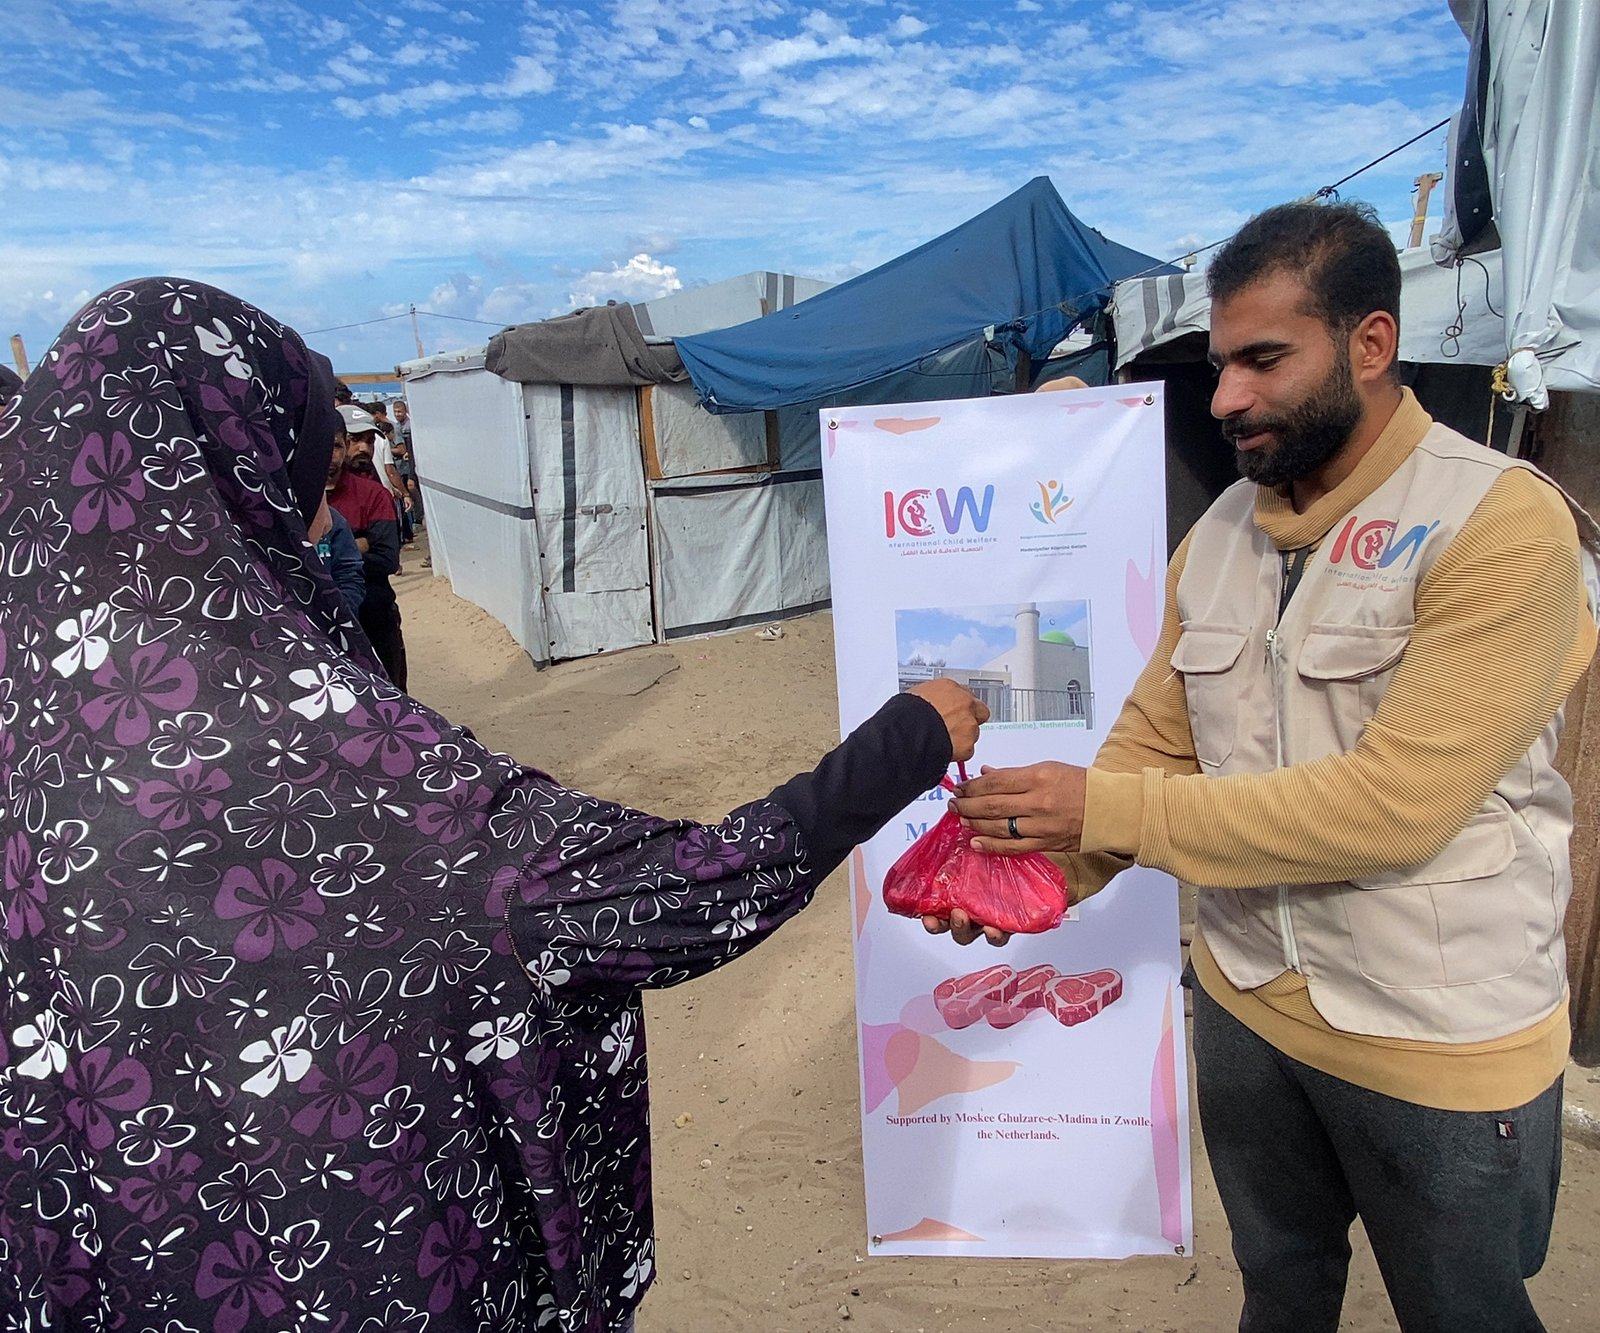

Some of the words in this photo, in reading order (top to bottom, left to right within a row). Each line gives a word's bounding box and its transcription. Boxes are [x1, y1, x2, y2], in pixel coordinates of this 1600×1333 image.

[884, 484, 994, 538] ICW
[888, 539, 940, 549] nternational
[942, 537, 964, 546] Child
[966, 536, 998, 545] Welfare
[886, 1114, 937, 1127] Supported
[940, 1113, 952, 1125] by
[955, 1112, 995, 1123] Moskee
[1101, 1114, 1111, 1125] in
[1114, 1115, 1154, 1128] Zwolle,
[977, 1130, 993, 1140] the
[995, 1129, 1060, 1141] Netherlands.
